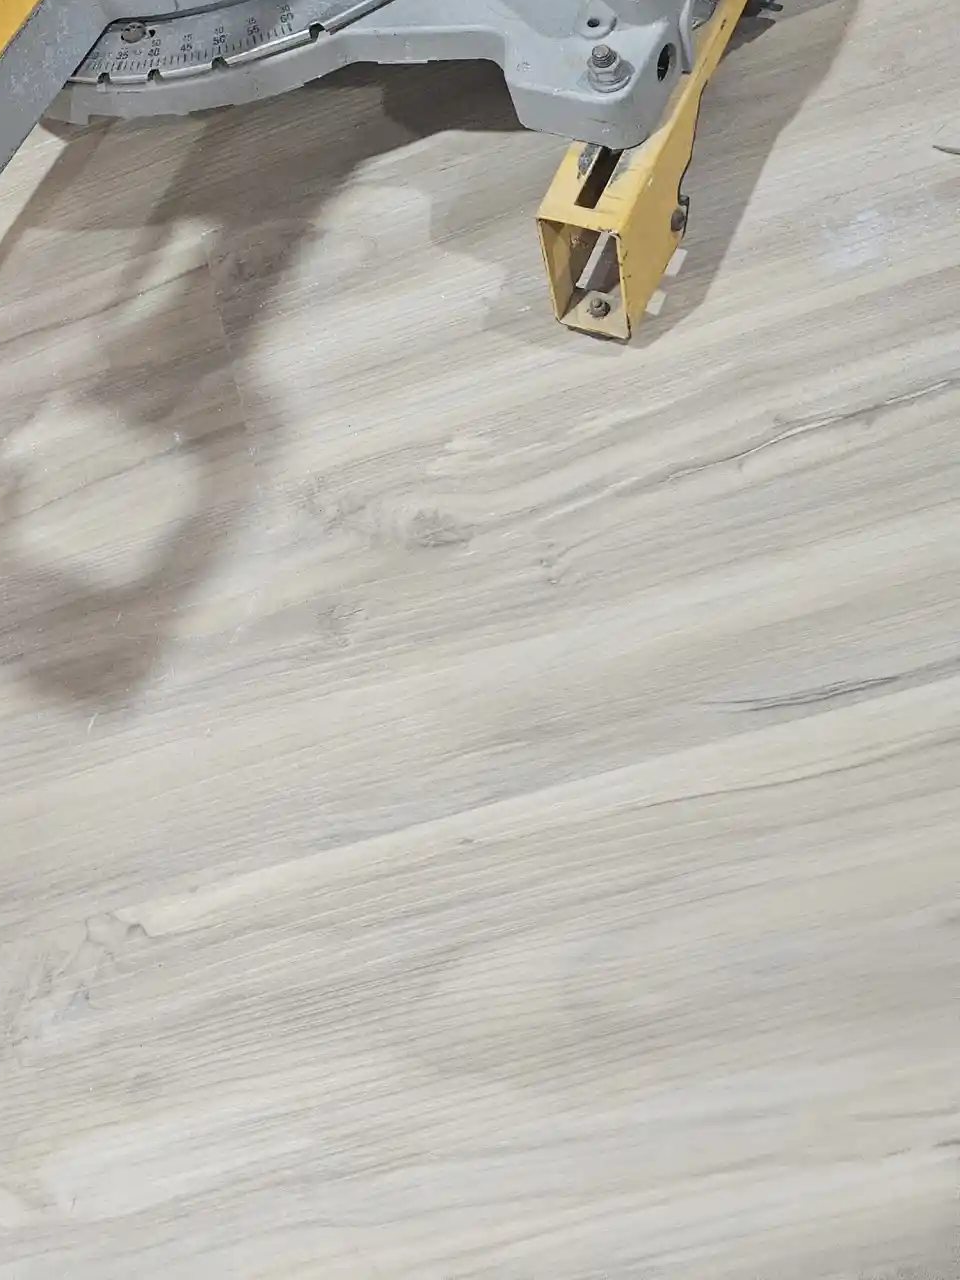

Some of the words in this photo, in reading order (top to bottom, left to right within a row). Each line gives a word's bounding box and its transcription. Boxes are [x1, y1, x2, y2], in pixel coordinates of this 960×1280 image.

[148, 47, 160, 57] 40
[180, 42, 193, 53] 45
[212, 33, 226, 46] 50
[246, 24, 261, 36] 55
[280, 12, 295, 24] 60
